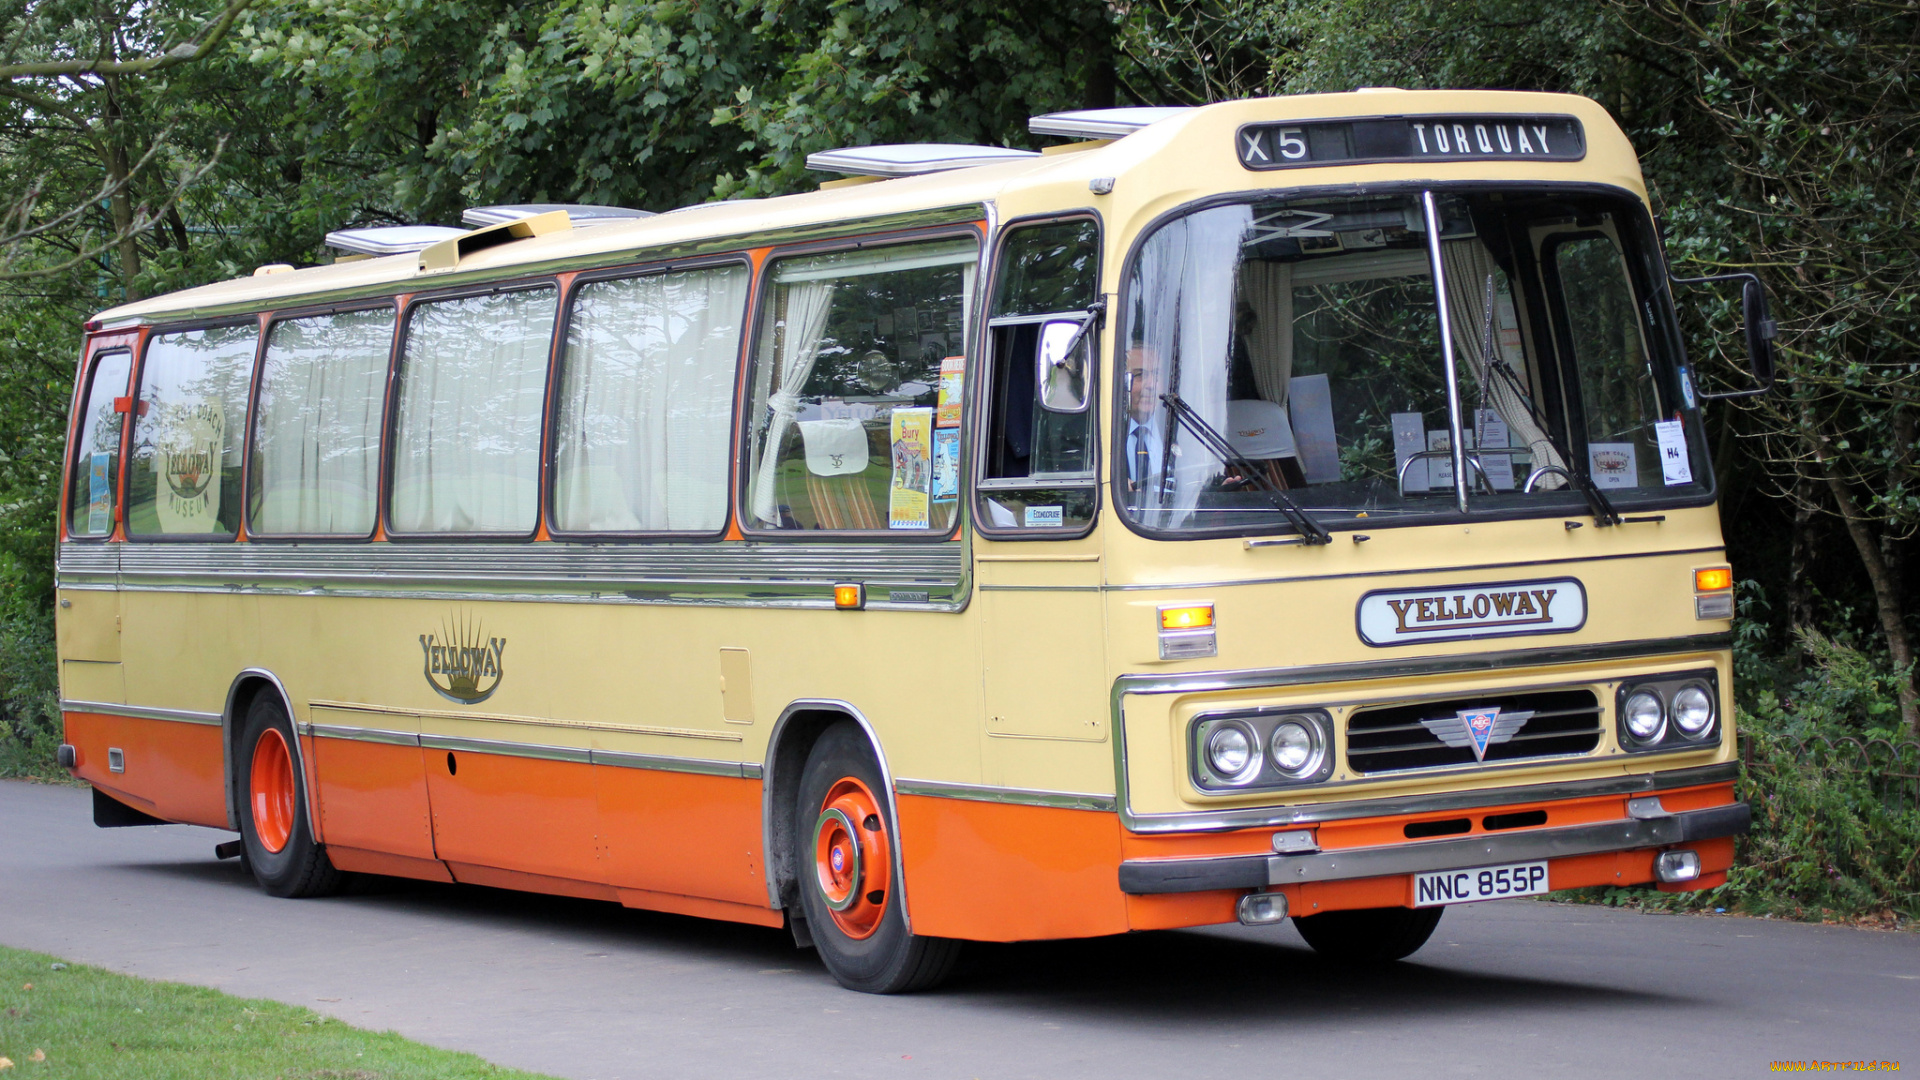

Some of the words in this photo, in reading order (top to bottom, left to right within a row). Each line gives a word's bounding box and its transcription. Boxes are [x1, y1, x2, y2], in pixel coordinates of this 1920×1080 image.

[1413, 123, 1550, 155] TORQUAY
[1645, 301, 1656, 326] PUSH
[197, 404, 222, 439] COACH
[902, 427, 919, 441] Bury
[1666, 447, 1679, 459] H4
[168, 489, 209, 518] MUSEUM
[1386, 589, 1557, 634] YELLOWAY
[418, 633, 507, 692] YELLOWAY
[1472, 718, 1489, 726] AEC
[1418, 872, 1470, 902] NNC
[1478, 865, 1545, 894] 855P
